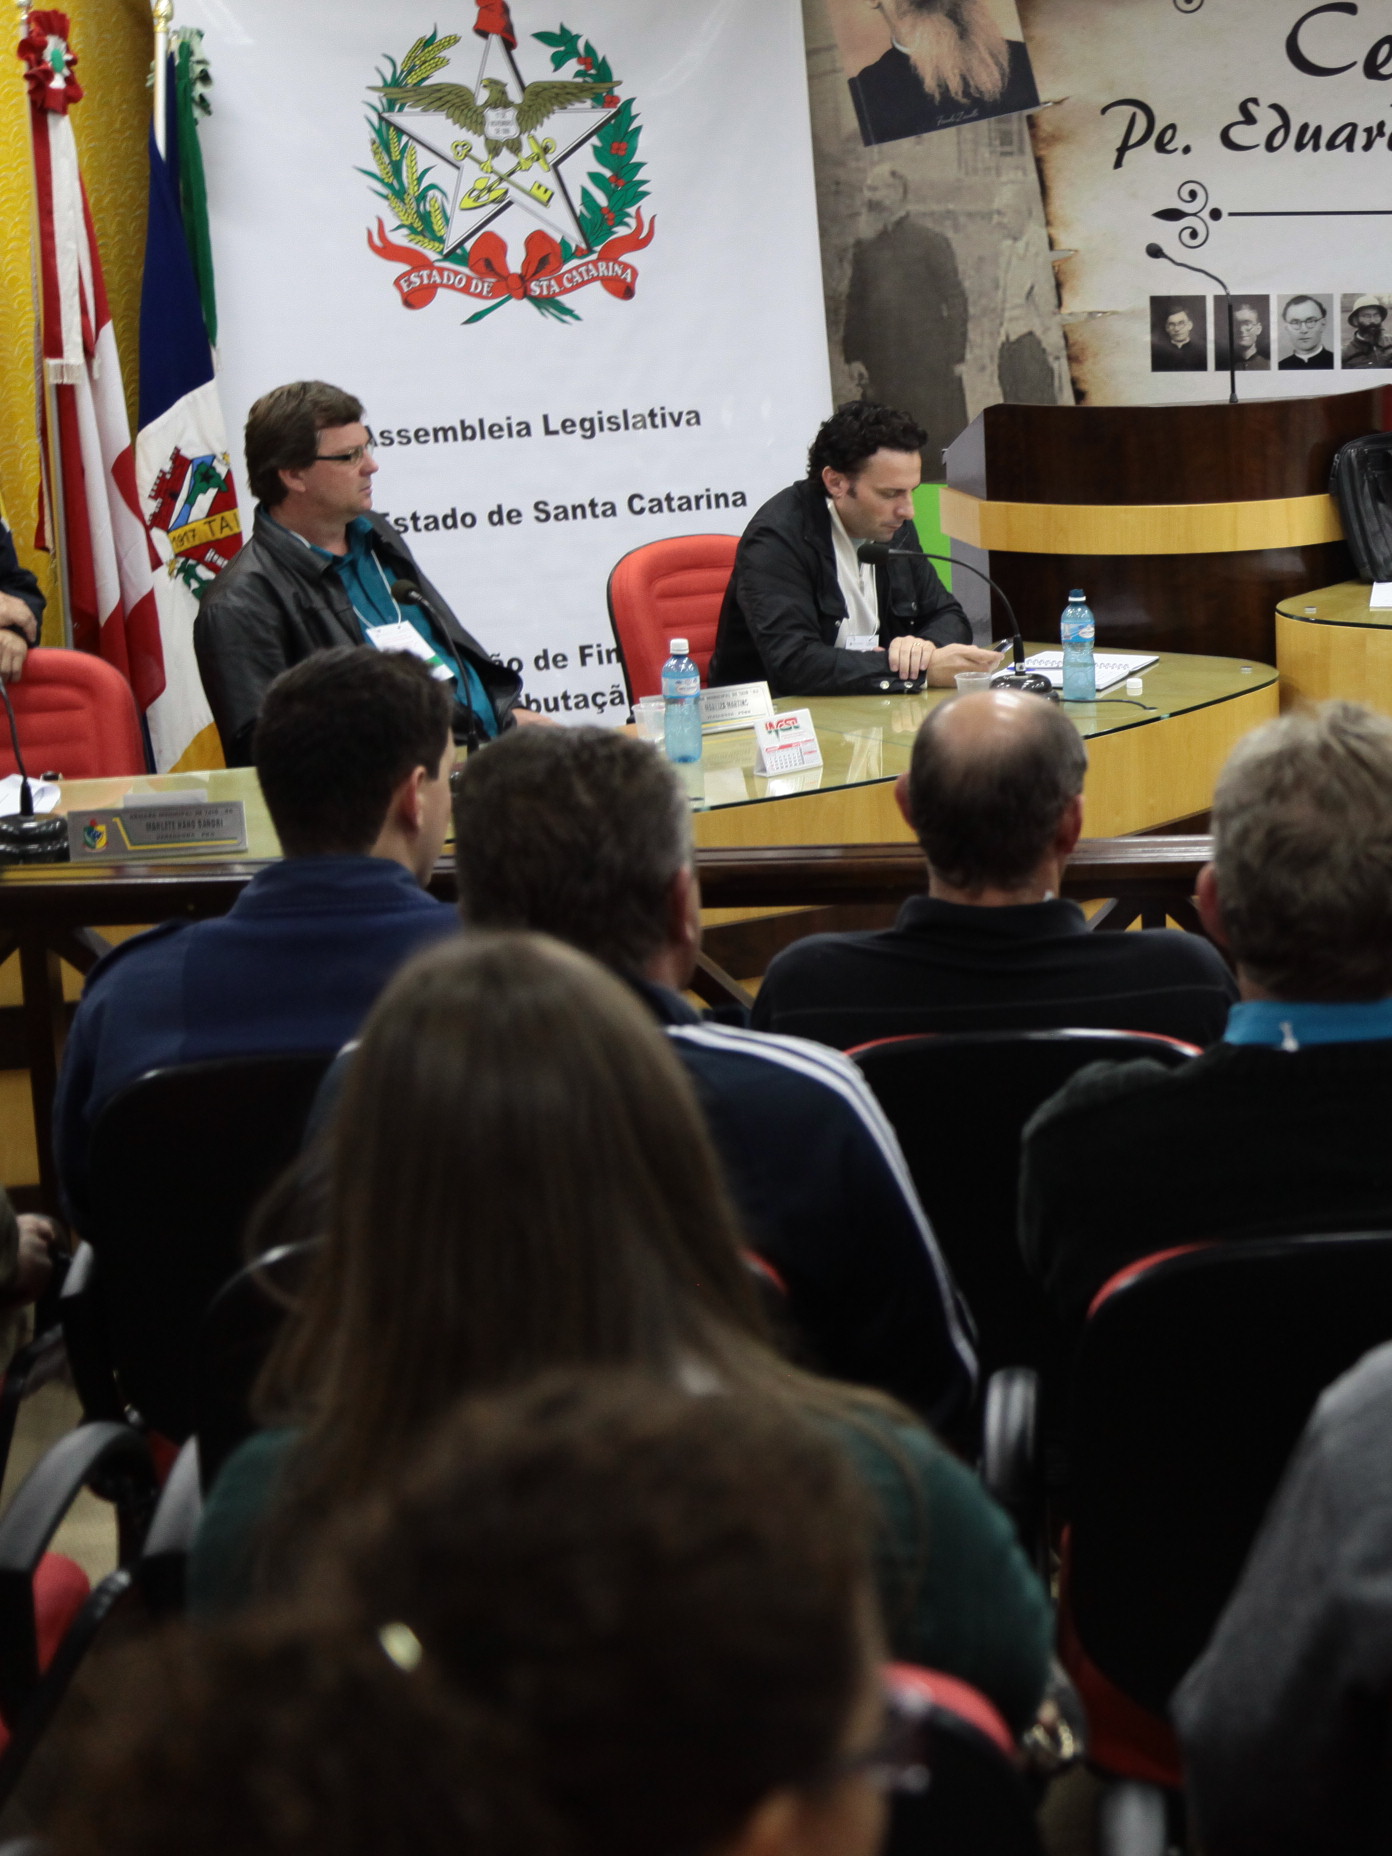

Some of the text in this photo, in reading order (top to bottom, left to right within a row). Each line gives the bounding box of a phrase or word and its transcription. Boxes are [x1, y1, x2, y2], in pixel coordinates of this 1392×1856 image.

[1100, 98, 1192, 170] Pe.
[401, 270, 466, 293] ESTADO
[469, 278, 494, 297] DE
[542, 405, 701, 440] Legislativa
[204, 512, 240, 537] TAI
[380, 487, 748, 534] stado de Santa Catarina
[533, 648, 569, 671] de
[578, 642, 622, 668] Fin
[518, 684, 626, 714] butaçã
